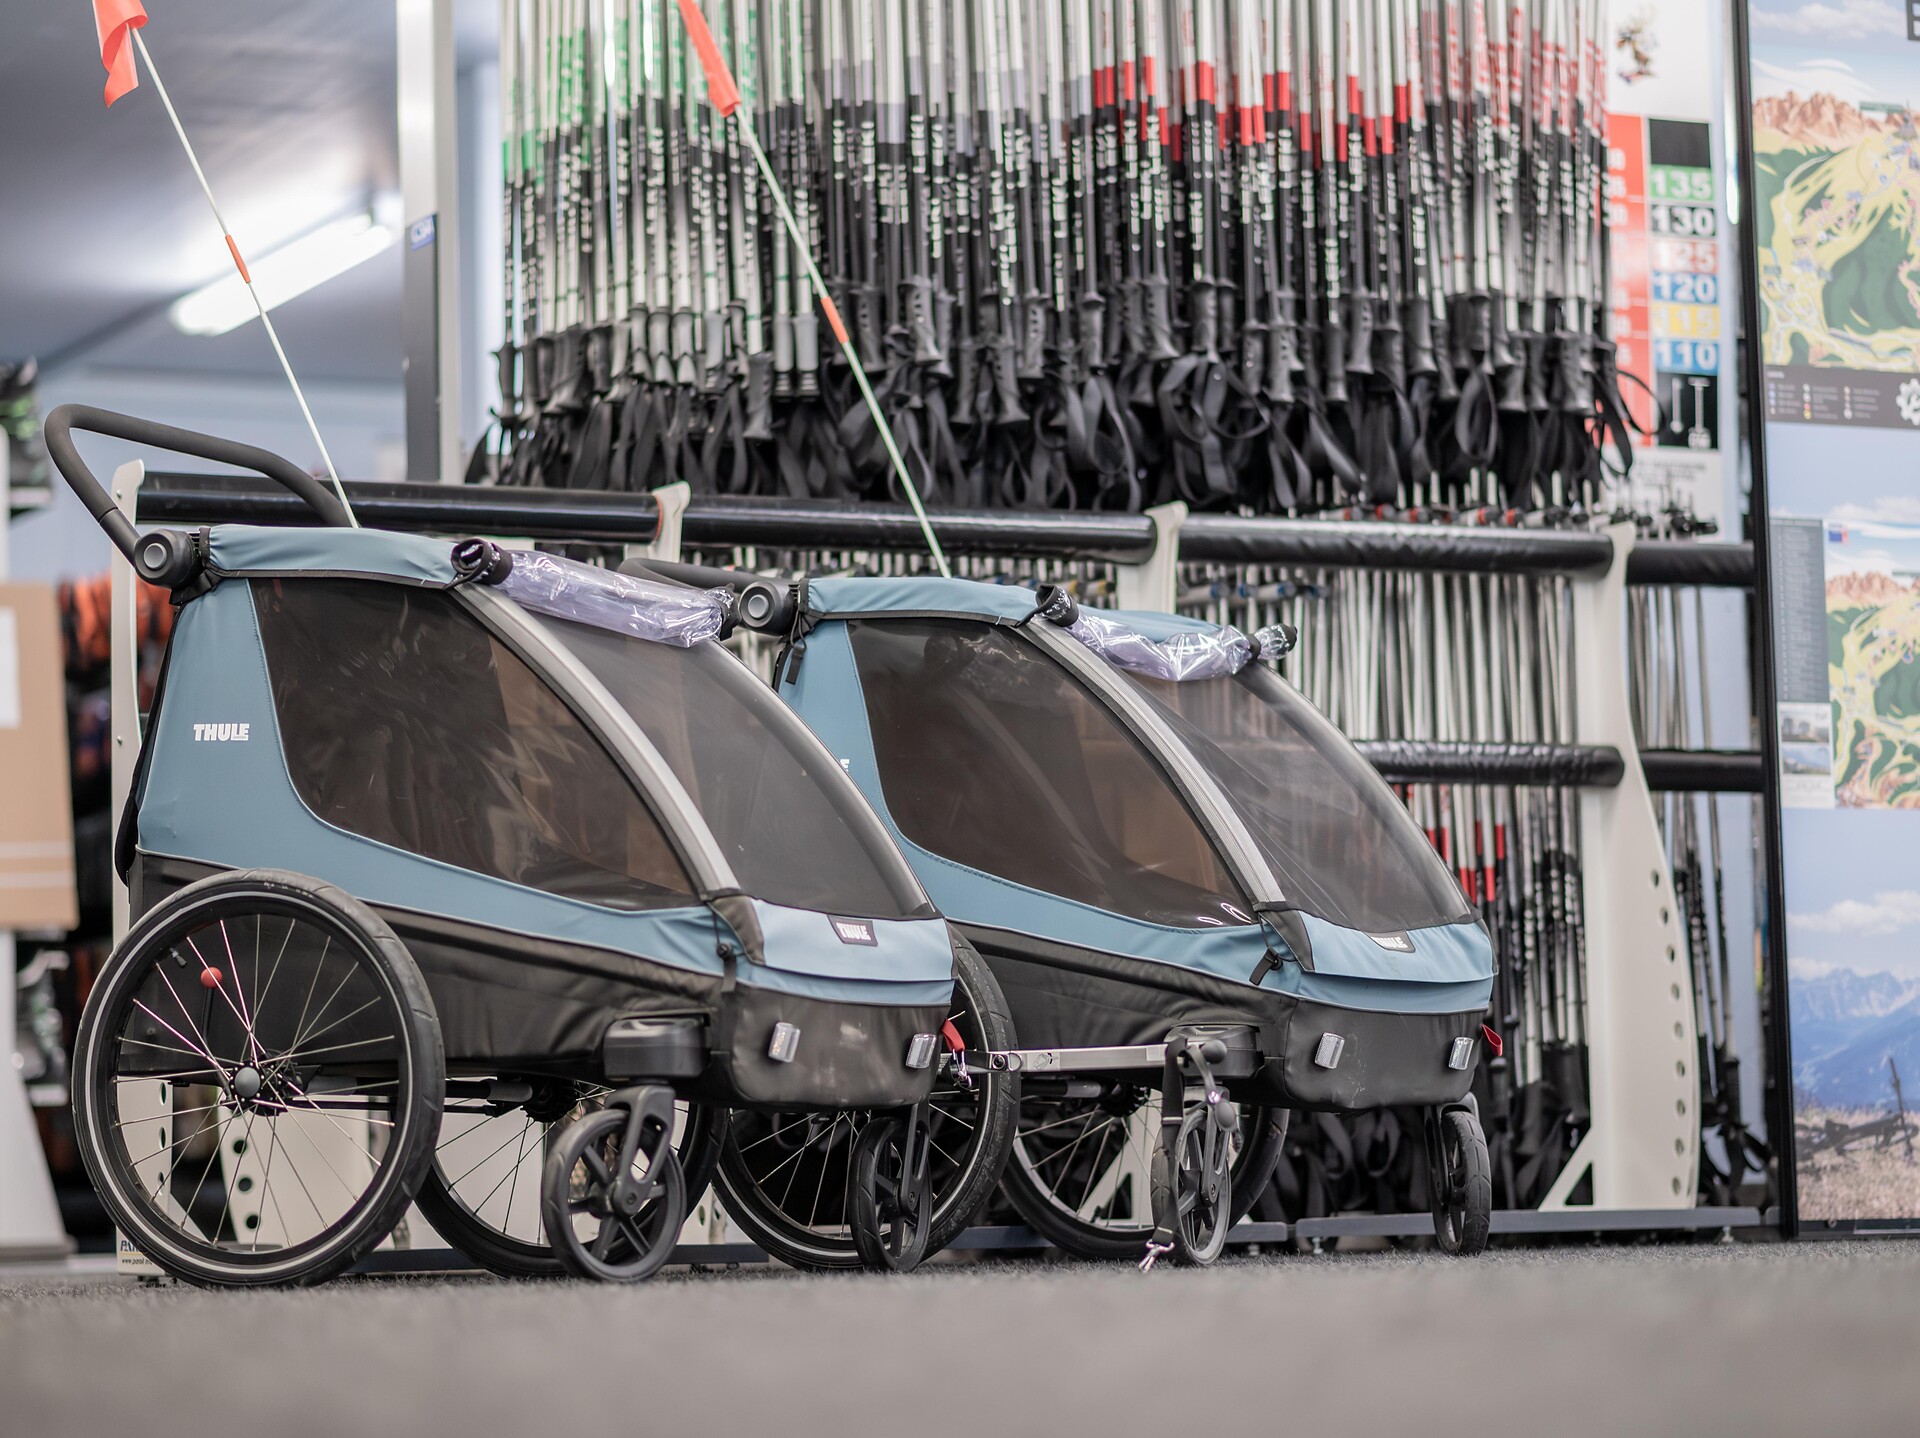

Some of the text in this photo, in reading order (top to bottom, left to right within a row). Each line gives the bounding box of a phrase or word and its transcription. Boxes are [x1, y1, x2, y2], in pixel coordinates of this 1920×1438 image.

[1651, 171, 1711, 200] 135
[1651, 206, 1714, 236] 130
[1653, 272, 1715, 301] 120
[1656, 342, 1718, 371] 110
[193, 723, 250, 741] THULE
[836, 922, 872, 941] THULE
